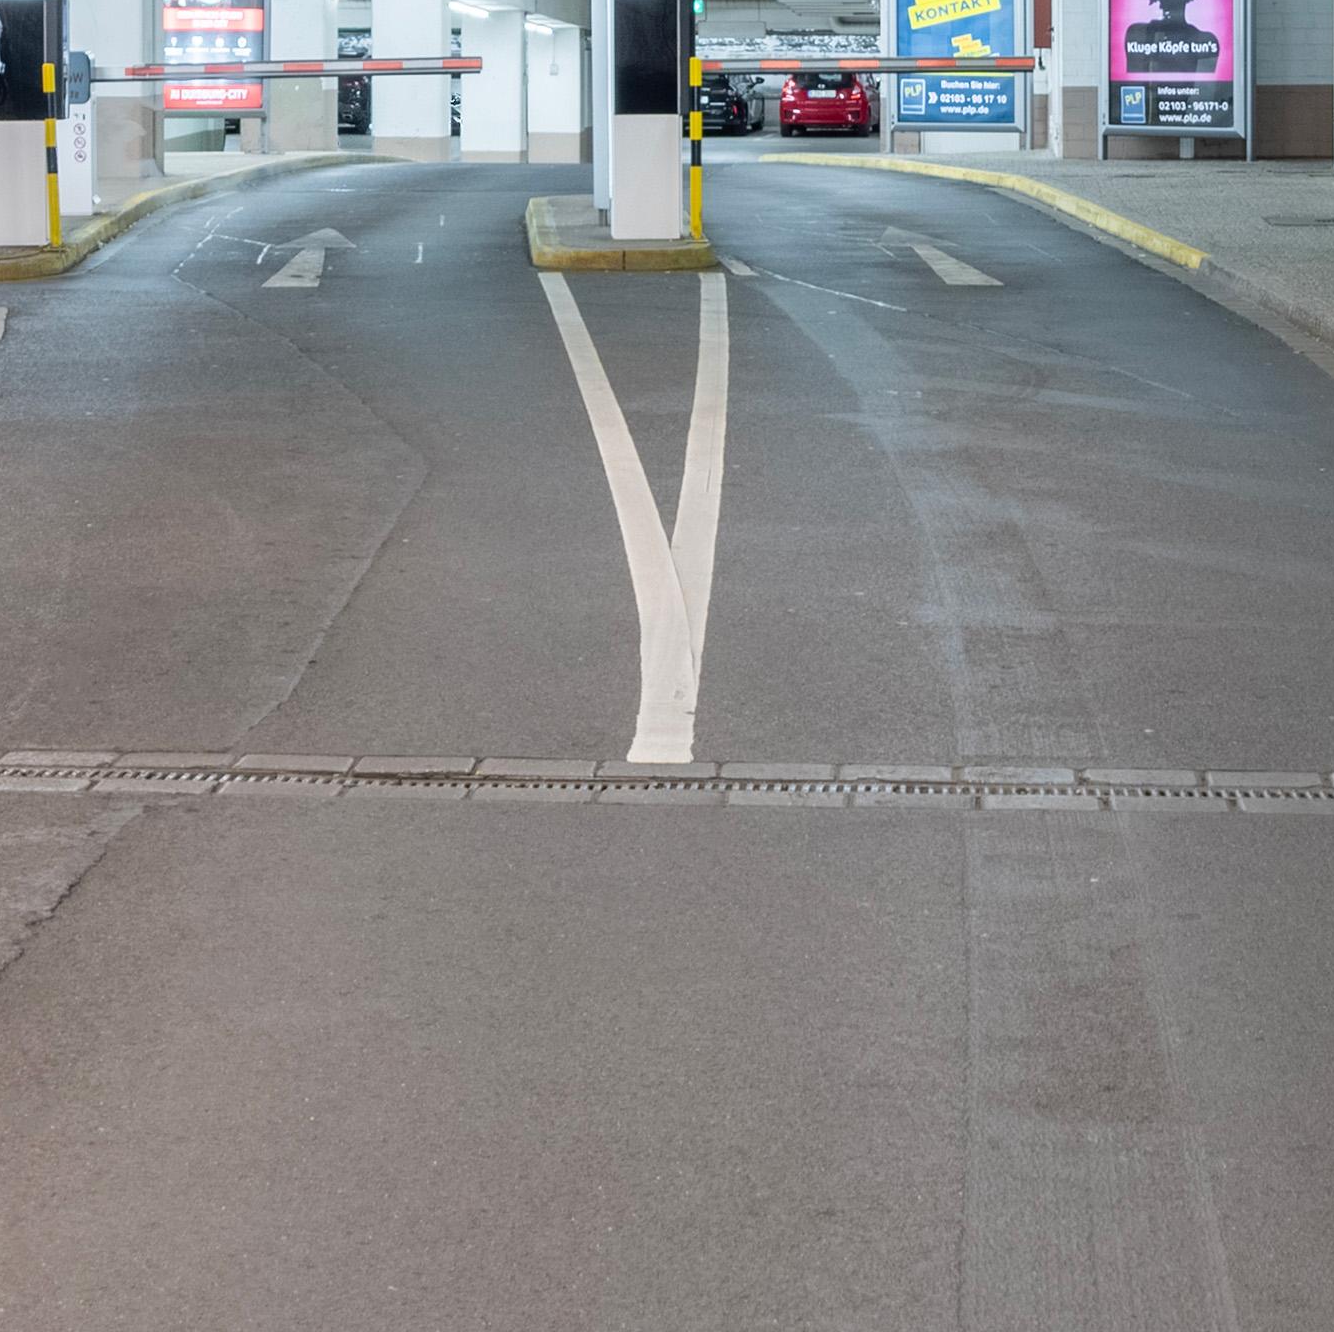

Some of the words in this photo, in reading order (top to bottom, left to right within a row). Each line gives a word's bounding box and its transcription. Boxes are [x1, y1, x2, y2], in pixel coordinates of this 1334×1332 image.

[1127, 42, 1157, 55] Kluge
[1159, 41, 1189, 55] Köpfe
[1191, 41, 1218, 53] tun's
[904, 84, 922, 98] PLP
[1157, 87, 1176, 95] Infos
[1177, 87, 1200, 95] unter:
[1124, 91, 1142, 106] PLP
[1158, 101, 1186, 111] 02103
[1158, 113, 1212, 124] www.plp.de
